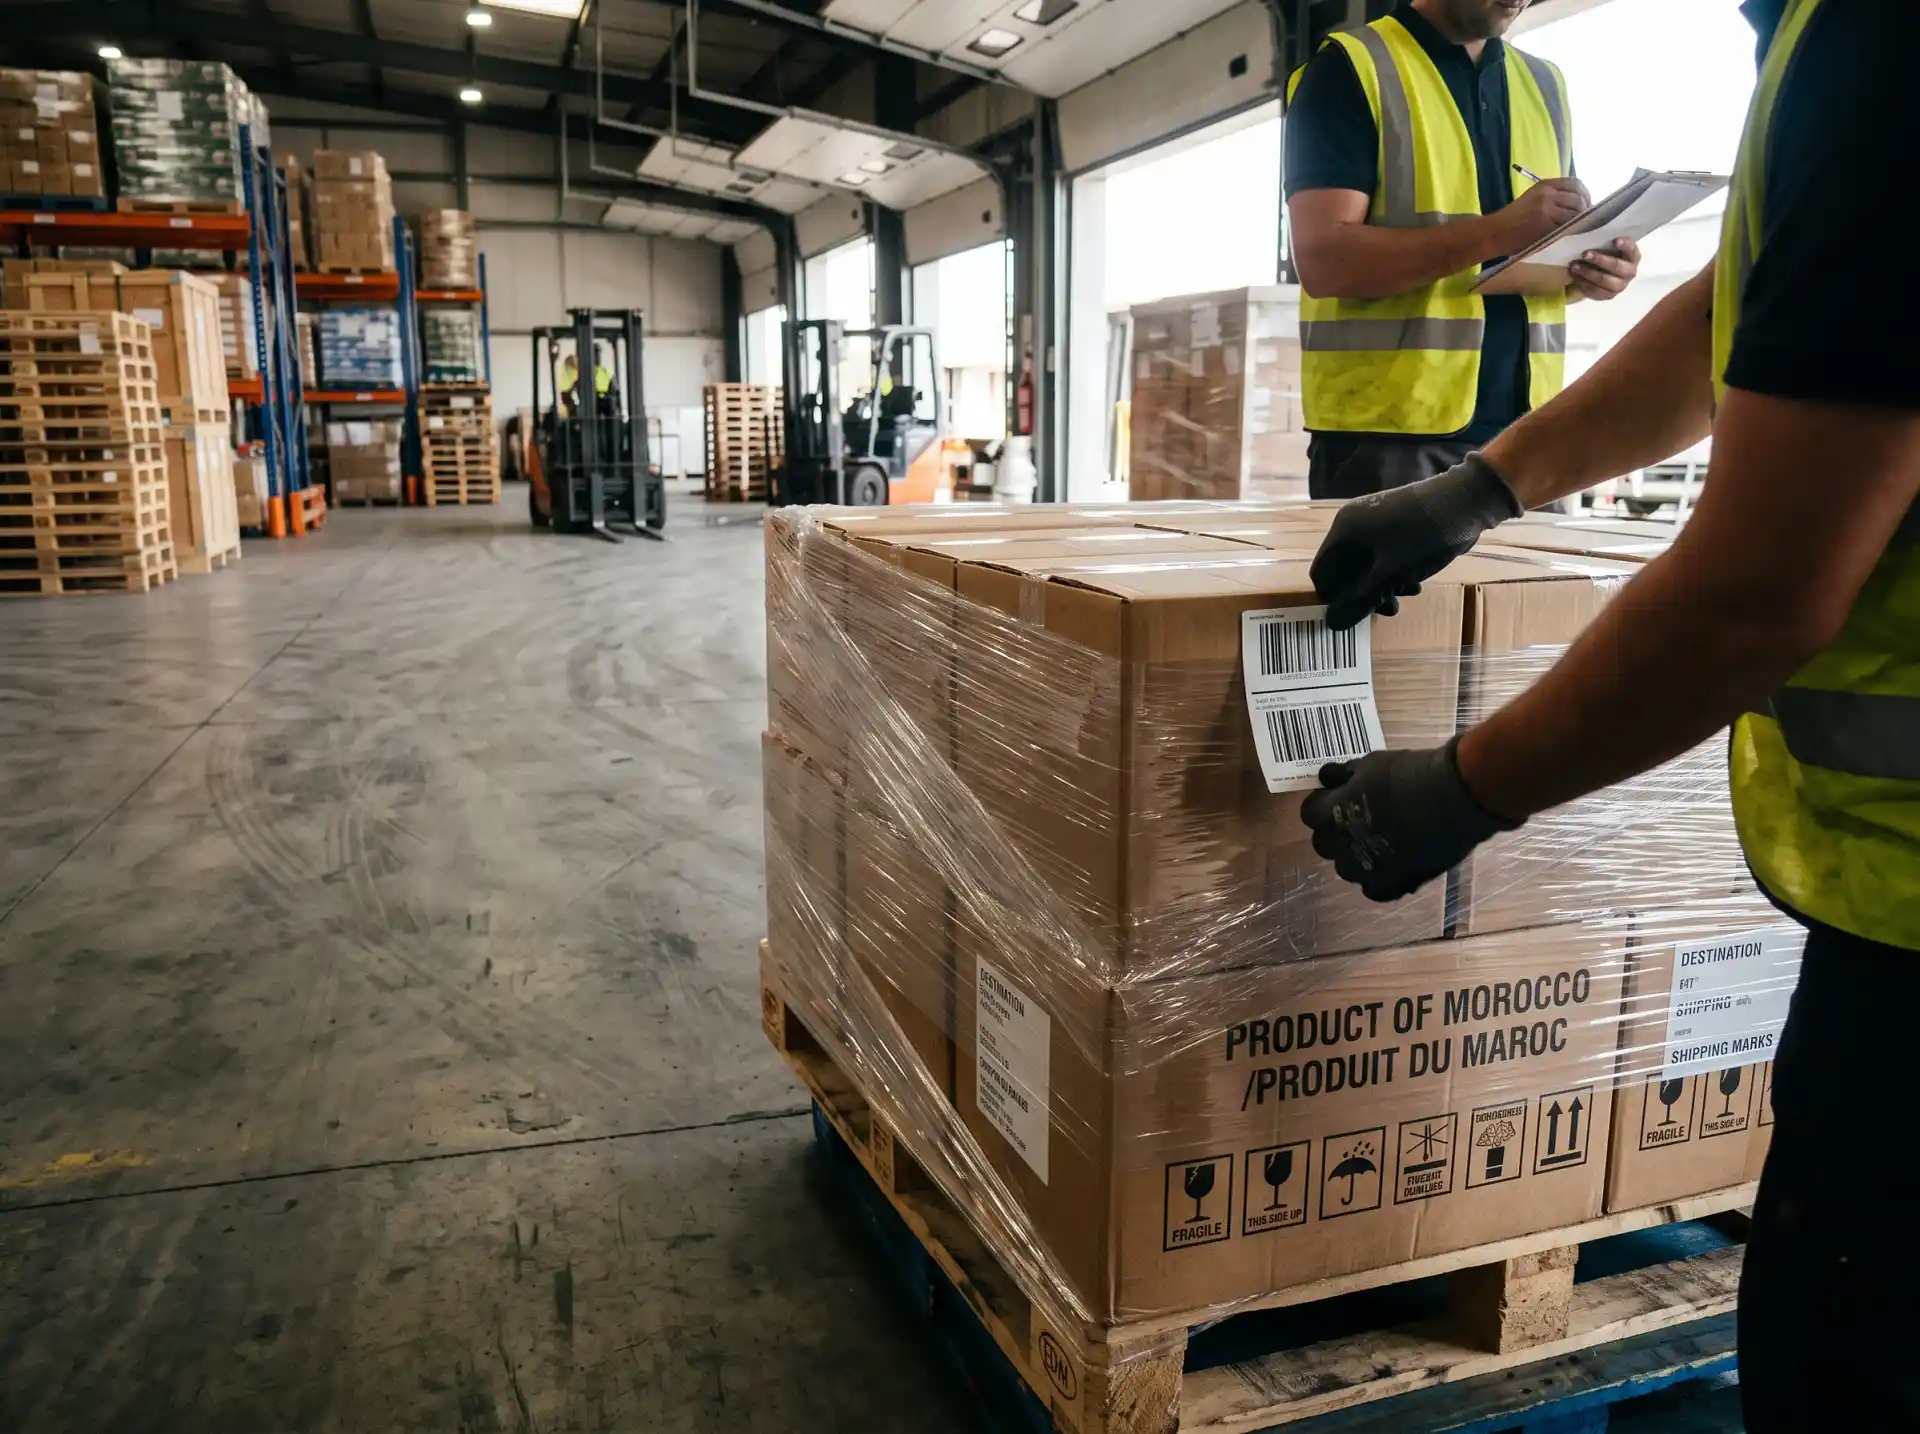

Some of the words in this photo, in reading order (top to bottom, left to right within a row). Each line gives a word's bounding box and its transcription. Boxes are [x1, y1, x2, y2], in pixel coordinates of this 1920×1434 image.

[1681, 942, 1762, 967] DESTINATION
[1226, 1002, 1384, 1061] PRODUCT
[1393, 994, 1434, 1035] OF
[1443, 968, 1592, 1026] MOROCCO
[1671, 1041, 1729, 1064] SHIPPING
[1731, 1033, 1773, 1054] MARKS
[1240, 1047, 1400, 1112] /PRODUIT
[1409, 1038, 1452, 1079] DU
[1461, 1018, 1568, 1069] MAROC
[1646, 1126, 1685, 1143] FRAGILE
[1704, 1122, 1719, 1132] THIS
[1720, 1119, 1734, 1129] SIDE
[1735, 1117, 1745, 1127] UP
[1248, 1214, 1268, 1228] THIS
[1268, 1210, 1289, 1225] SIDE
[1289, 1208, 1303, 1221] UP
[1171, 1222, 1222, 1243] FRAGILE
